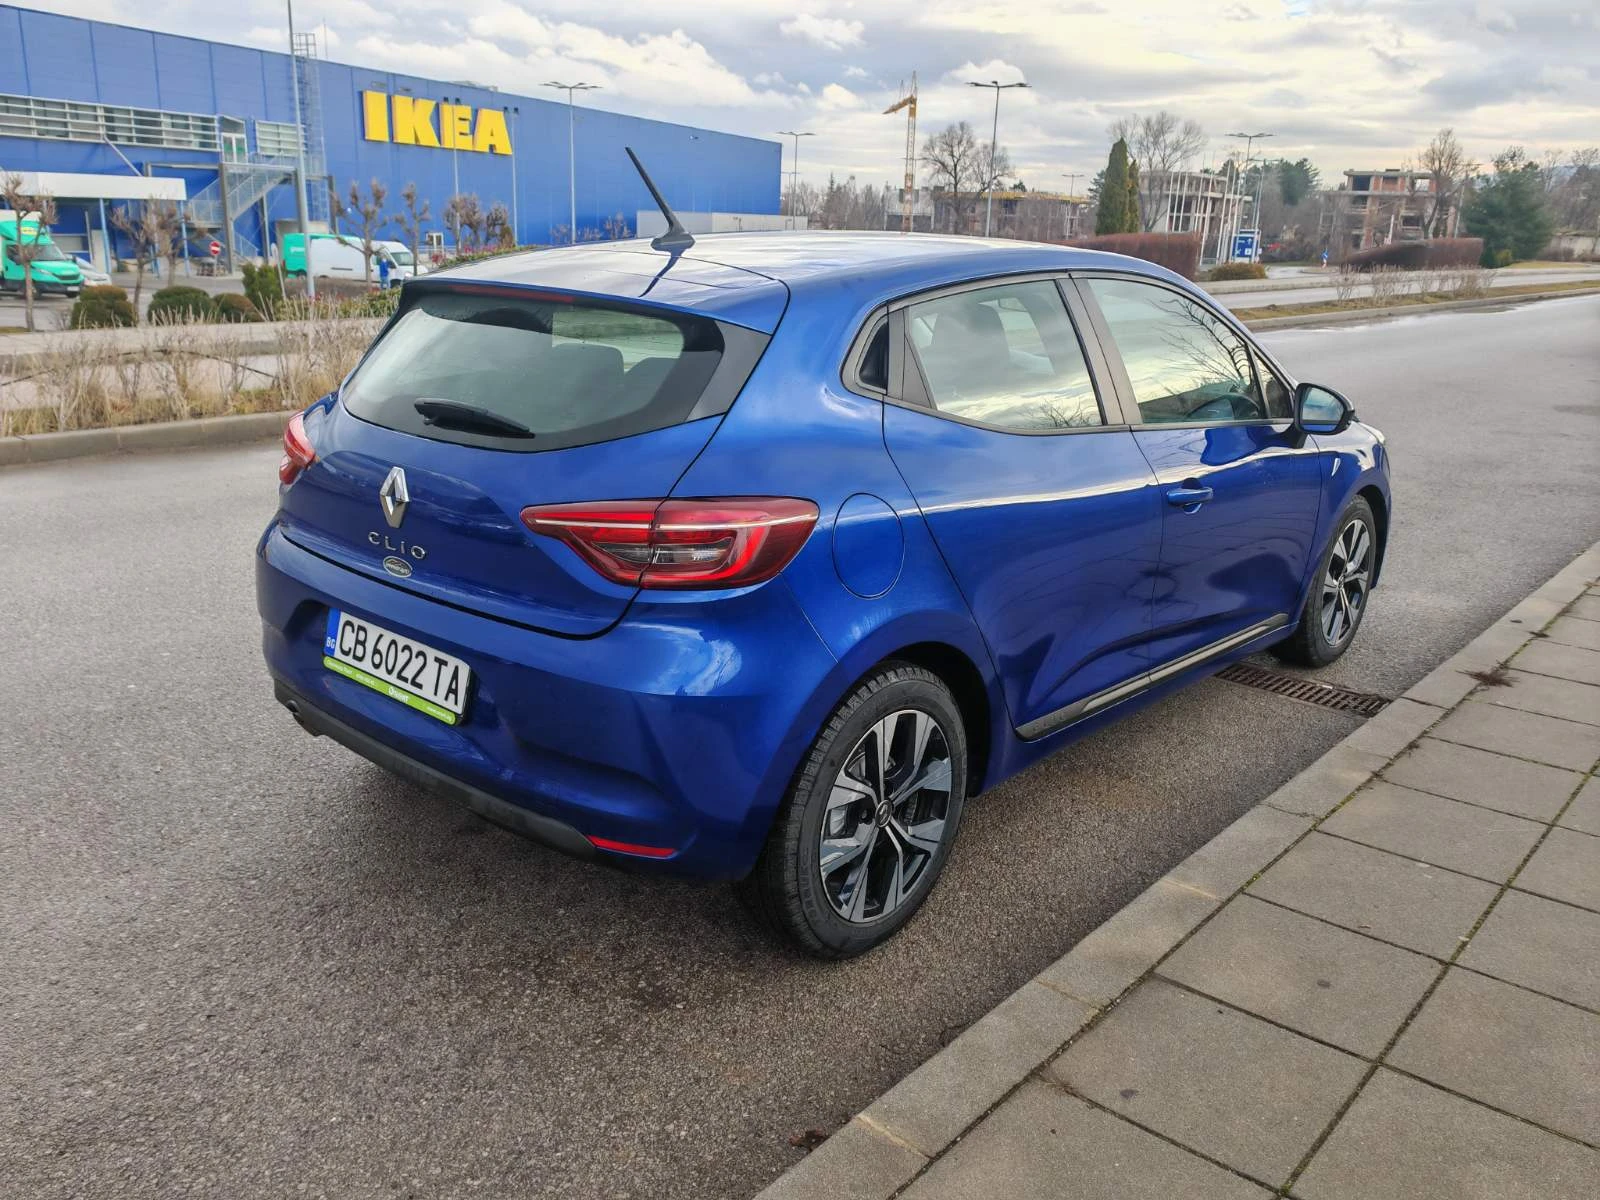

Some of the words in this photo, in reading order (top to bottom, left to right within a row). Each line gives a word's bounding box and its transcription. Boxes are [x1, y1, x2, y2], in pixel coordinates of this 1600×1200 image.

[363, 90, 513, 155] IKEA
[368, 531, 426, 559] CLIO
[326, 637, 336, 649] BG
[339, 619, 368, 663] CB
[371, 633, 428, 691] 6022
[432, 655, 459, 707] TA
